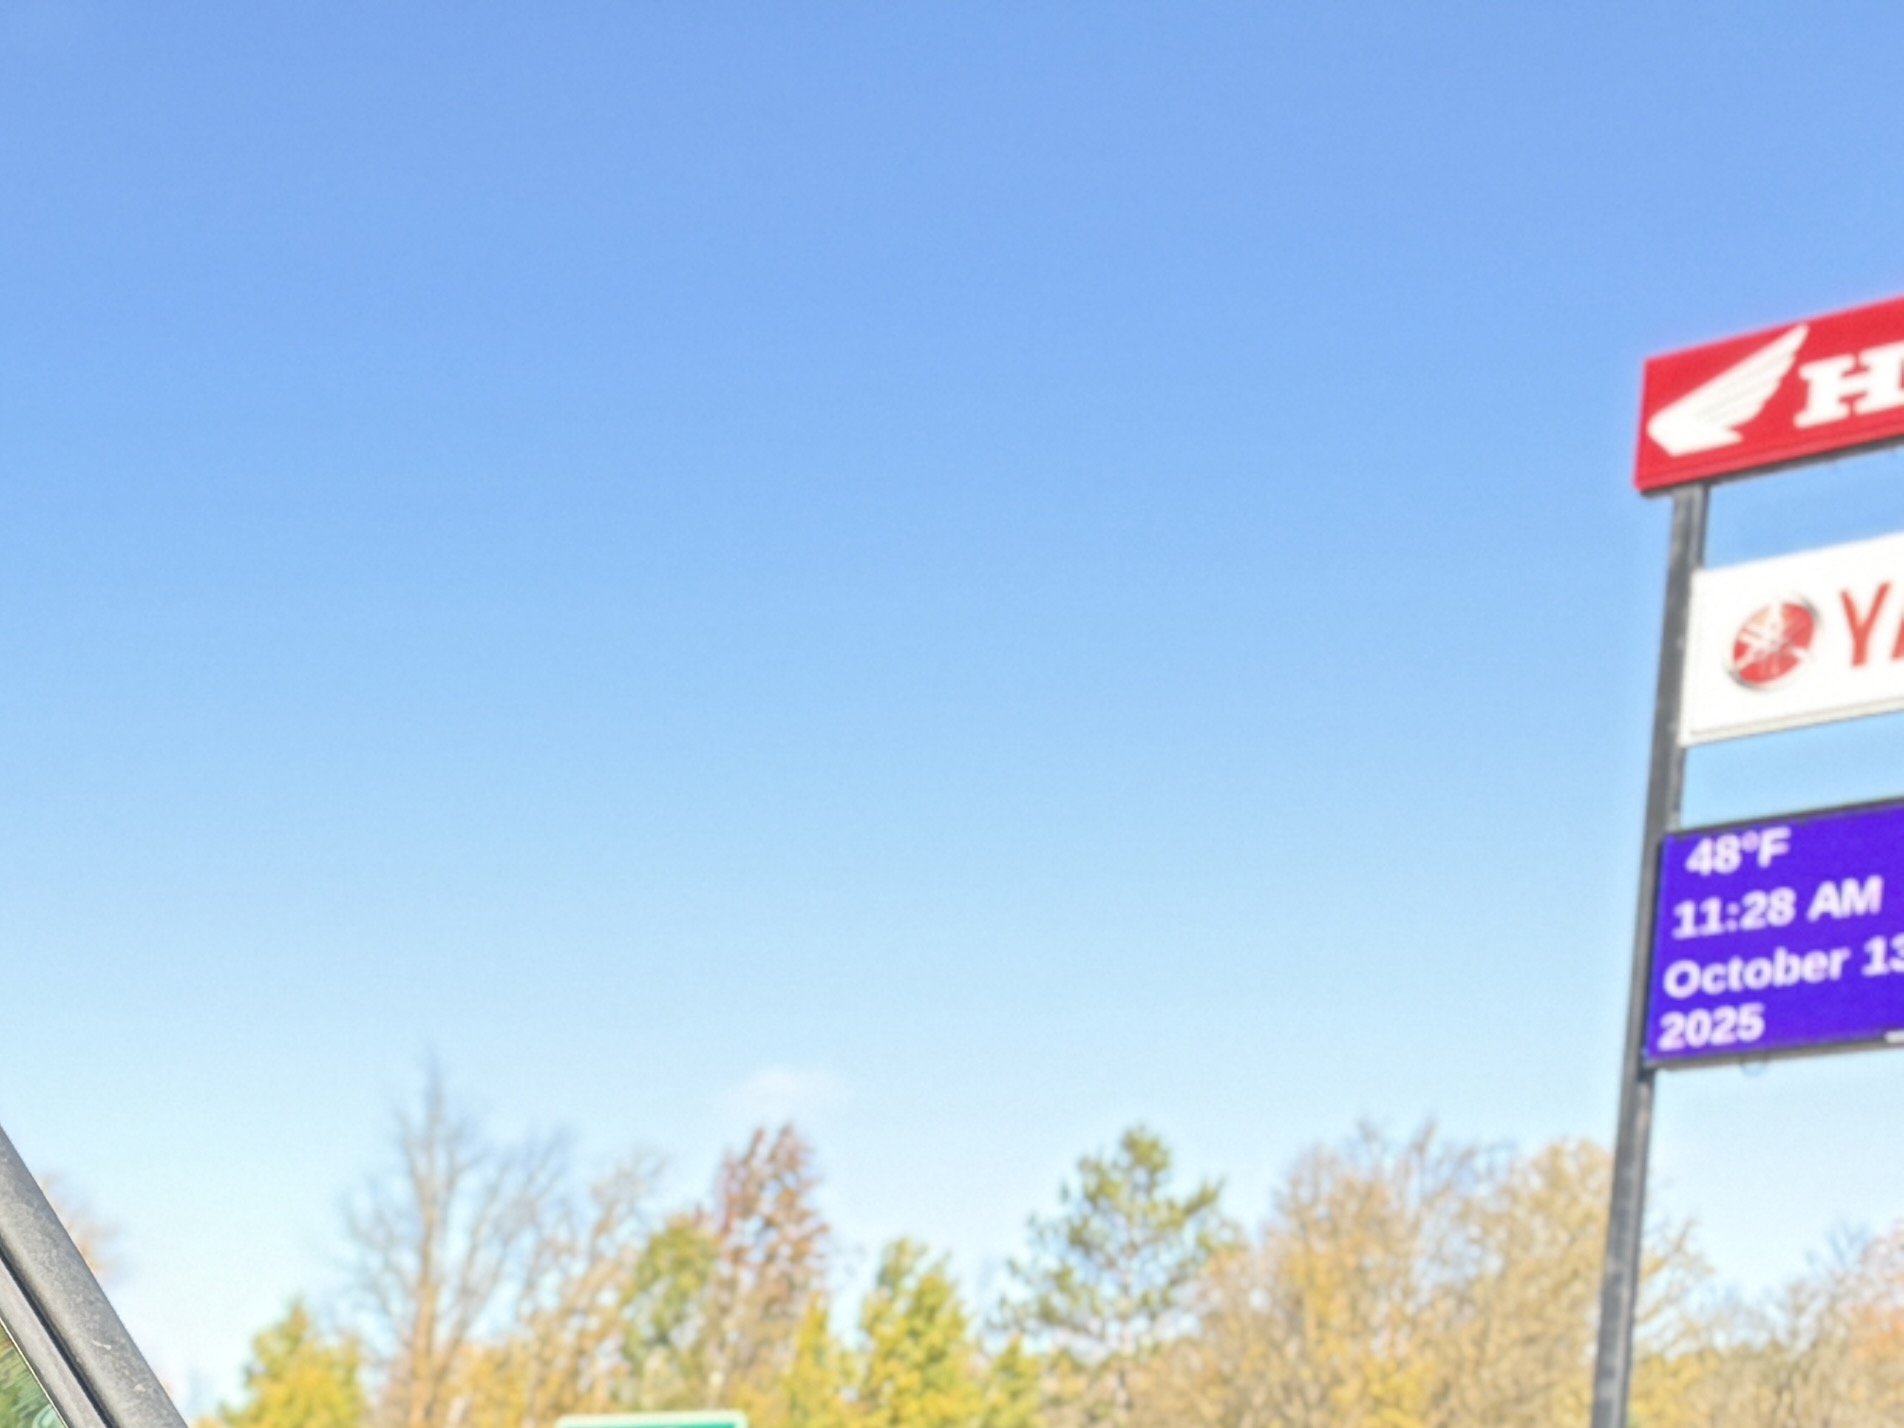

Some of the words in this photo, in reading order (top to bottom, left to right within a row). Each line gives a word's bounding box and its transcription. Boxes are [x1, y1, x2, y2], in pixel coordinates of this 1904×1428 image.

[1839, 580, 1904, 668] Y
[1685, 826, 1791, 876] 48°F
[1672, 887, 1796, 940] 11:28
[1806, 875, 1884, 922] AM
[1663, 946, 1851, 999] October
[1656, 1002, 1765, 1050] 2025
